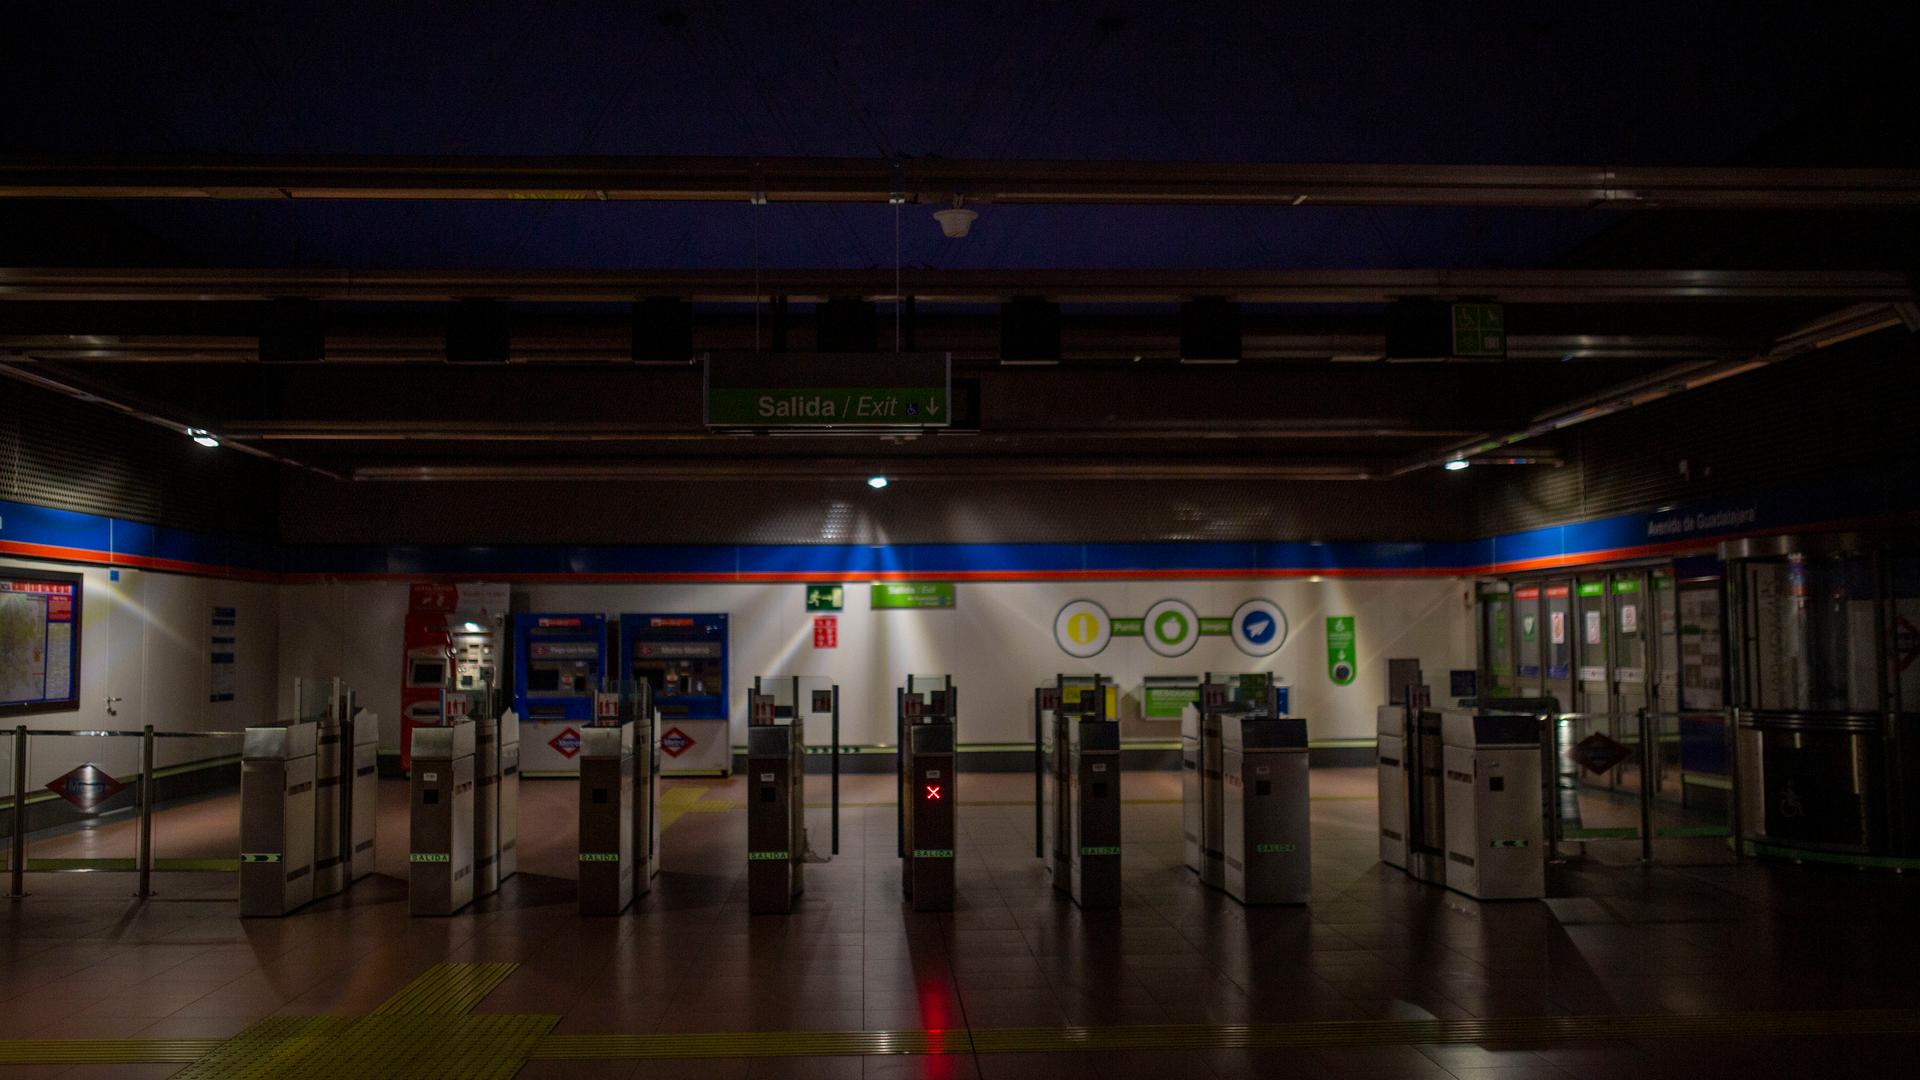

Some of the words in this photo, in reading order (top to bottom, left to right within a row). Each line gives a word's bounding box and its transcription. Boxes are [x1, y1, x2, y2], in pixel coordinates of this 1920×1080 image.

[758, 395, 836, 418] Salida
[842, 395, 852, 419] /
[856, 396, 899, 418] Exit
[411, 853, 449, 862] SALIDA
[580, 853, 618, 862] SALIDA
[750, 851, 787, 860] SALIDA
[915, 849, 953, 858] SALIDA
